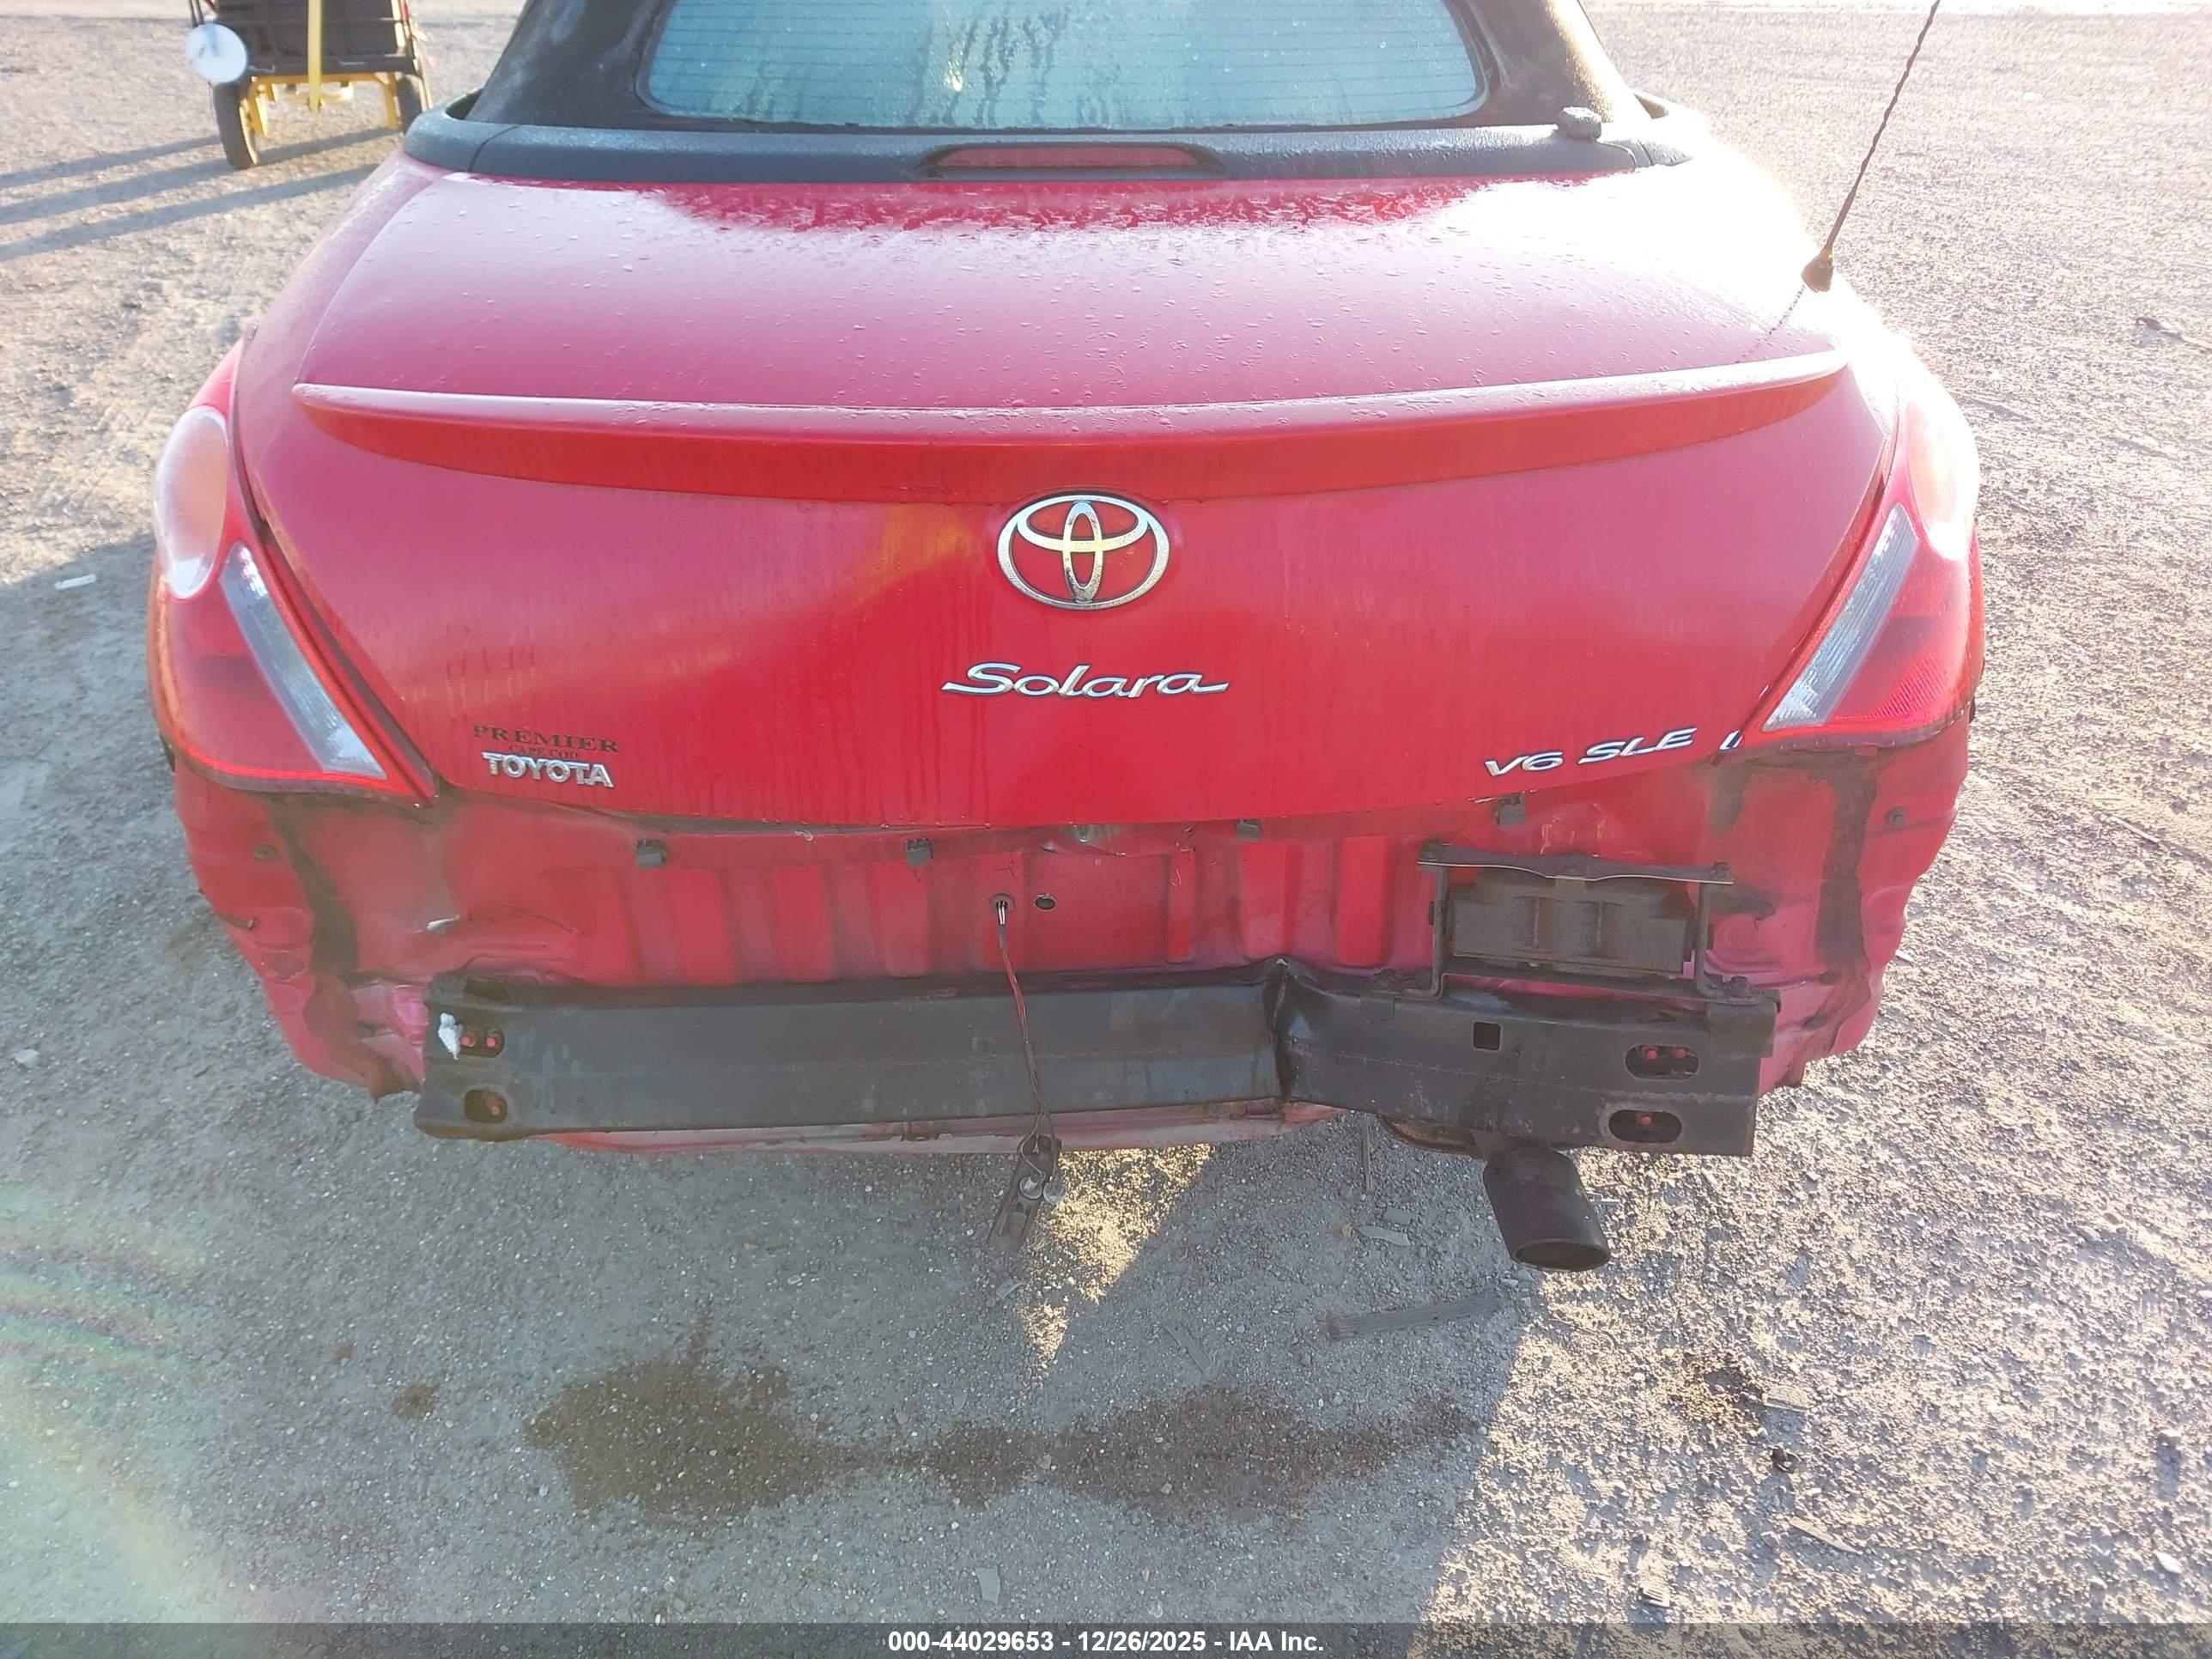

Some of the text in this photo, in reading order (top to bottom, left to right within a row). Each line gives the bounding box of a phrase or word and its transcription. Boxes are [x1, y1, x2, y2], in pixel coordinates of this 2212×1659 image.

[941, 661, 1230, 698] Solara
[471, 724, 620, 753] PREMIER
[508, 744, 579, 758] CAPE COD
[1484, 727, 1698, 777] V6 SLE
[481, 750, 615, 788] TOYOTA
